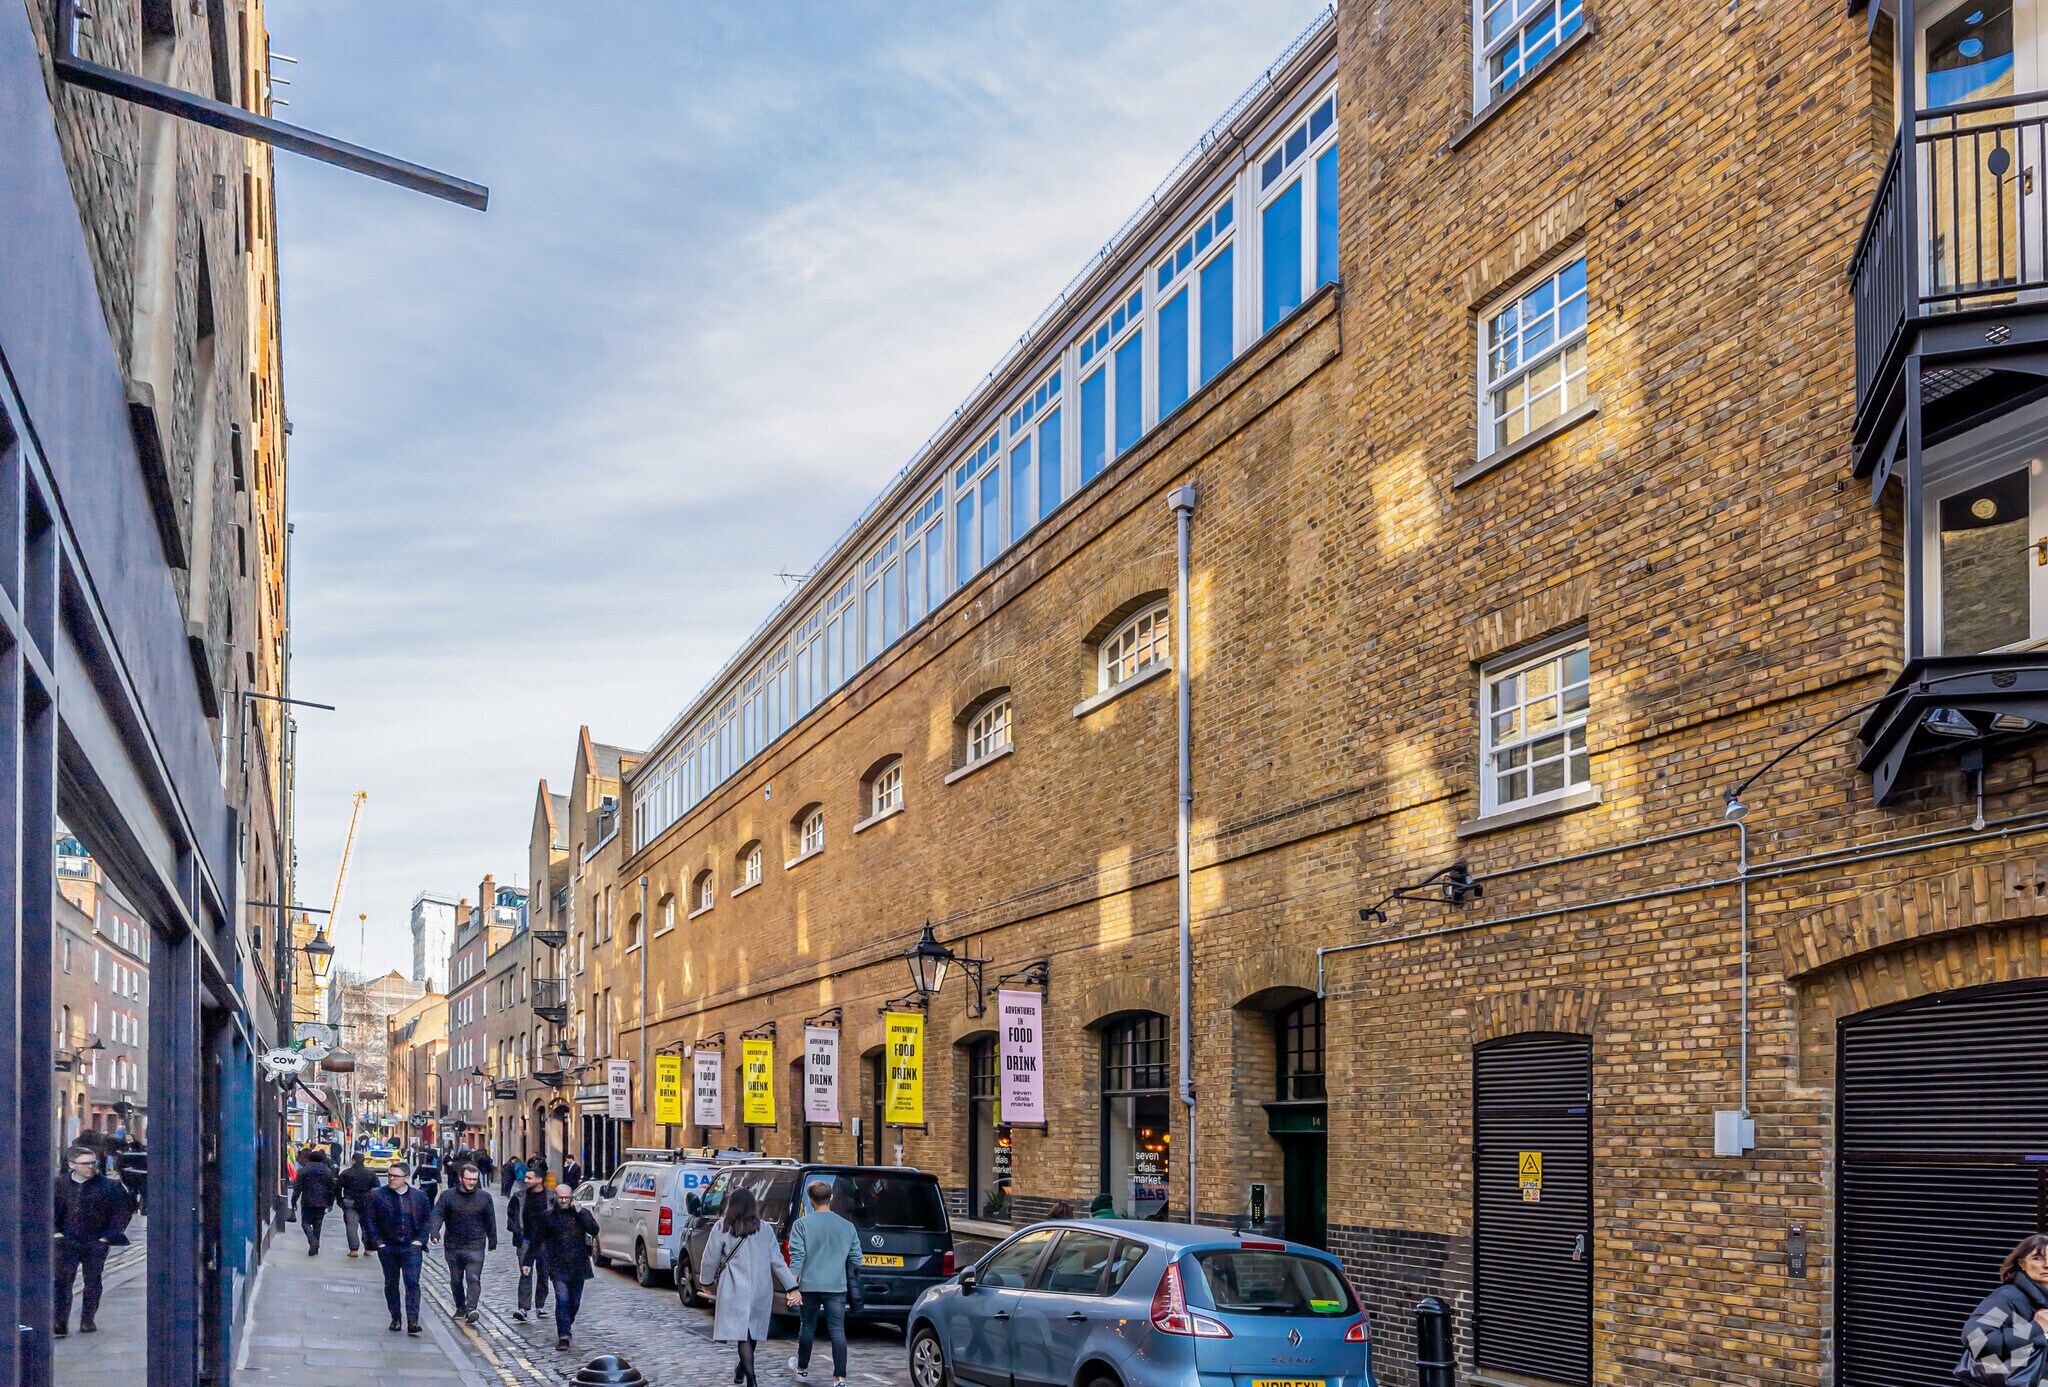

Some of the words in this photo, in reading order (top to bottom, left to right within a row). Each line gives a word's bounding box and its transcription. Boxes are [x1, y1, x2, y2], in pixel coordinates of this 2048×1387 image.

[1005, 1006, 1035, 1016] ADVENTURES
[892, 1026, 918, 1034] ADVENTURES
[1009, 1027, 1033, 1043] FOOD
[895, 1044, 915, 1056] FOOD
[273, 1056, 297, 1065] COW
[812, 1054, 831, 1066] FOOD
[1007, 1056, 1036, 1071] DRINK
[750, 1064, 766, 1073] FOOD
[892, 1067, 917, 1080] DRINK
[662, 1074, 676, 1083] FOOD
[700, 1072, 716, 1081] FOOD
[810, 1074, 833, 1086] DRINK
[1013, 1074, 1031, 1083] INSIDE
[748, 1081, 768, 1091] DRINK
[660, 1089, 677, 1097] DRINK
[699, 1088, 717, 1097] DRINK
[994, 1146, 1011, 1154] seven
[995, 1156, 1008, 1164] dials
[1135, 1151, 1160, 1161] seven
[1137, 1162, 1156, 1173] dials
[684, 1174, 714, 1189] BA
[1133, 1174, 1162, 1185] market
[880, 1257, 898, 1266] LMF
